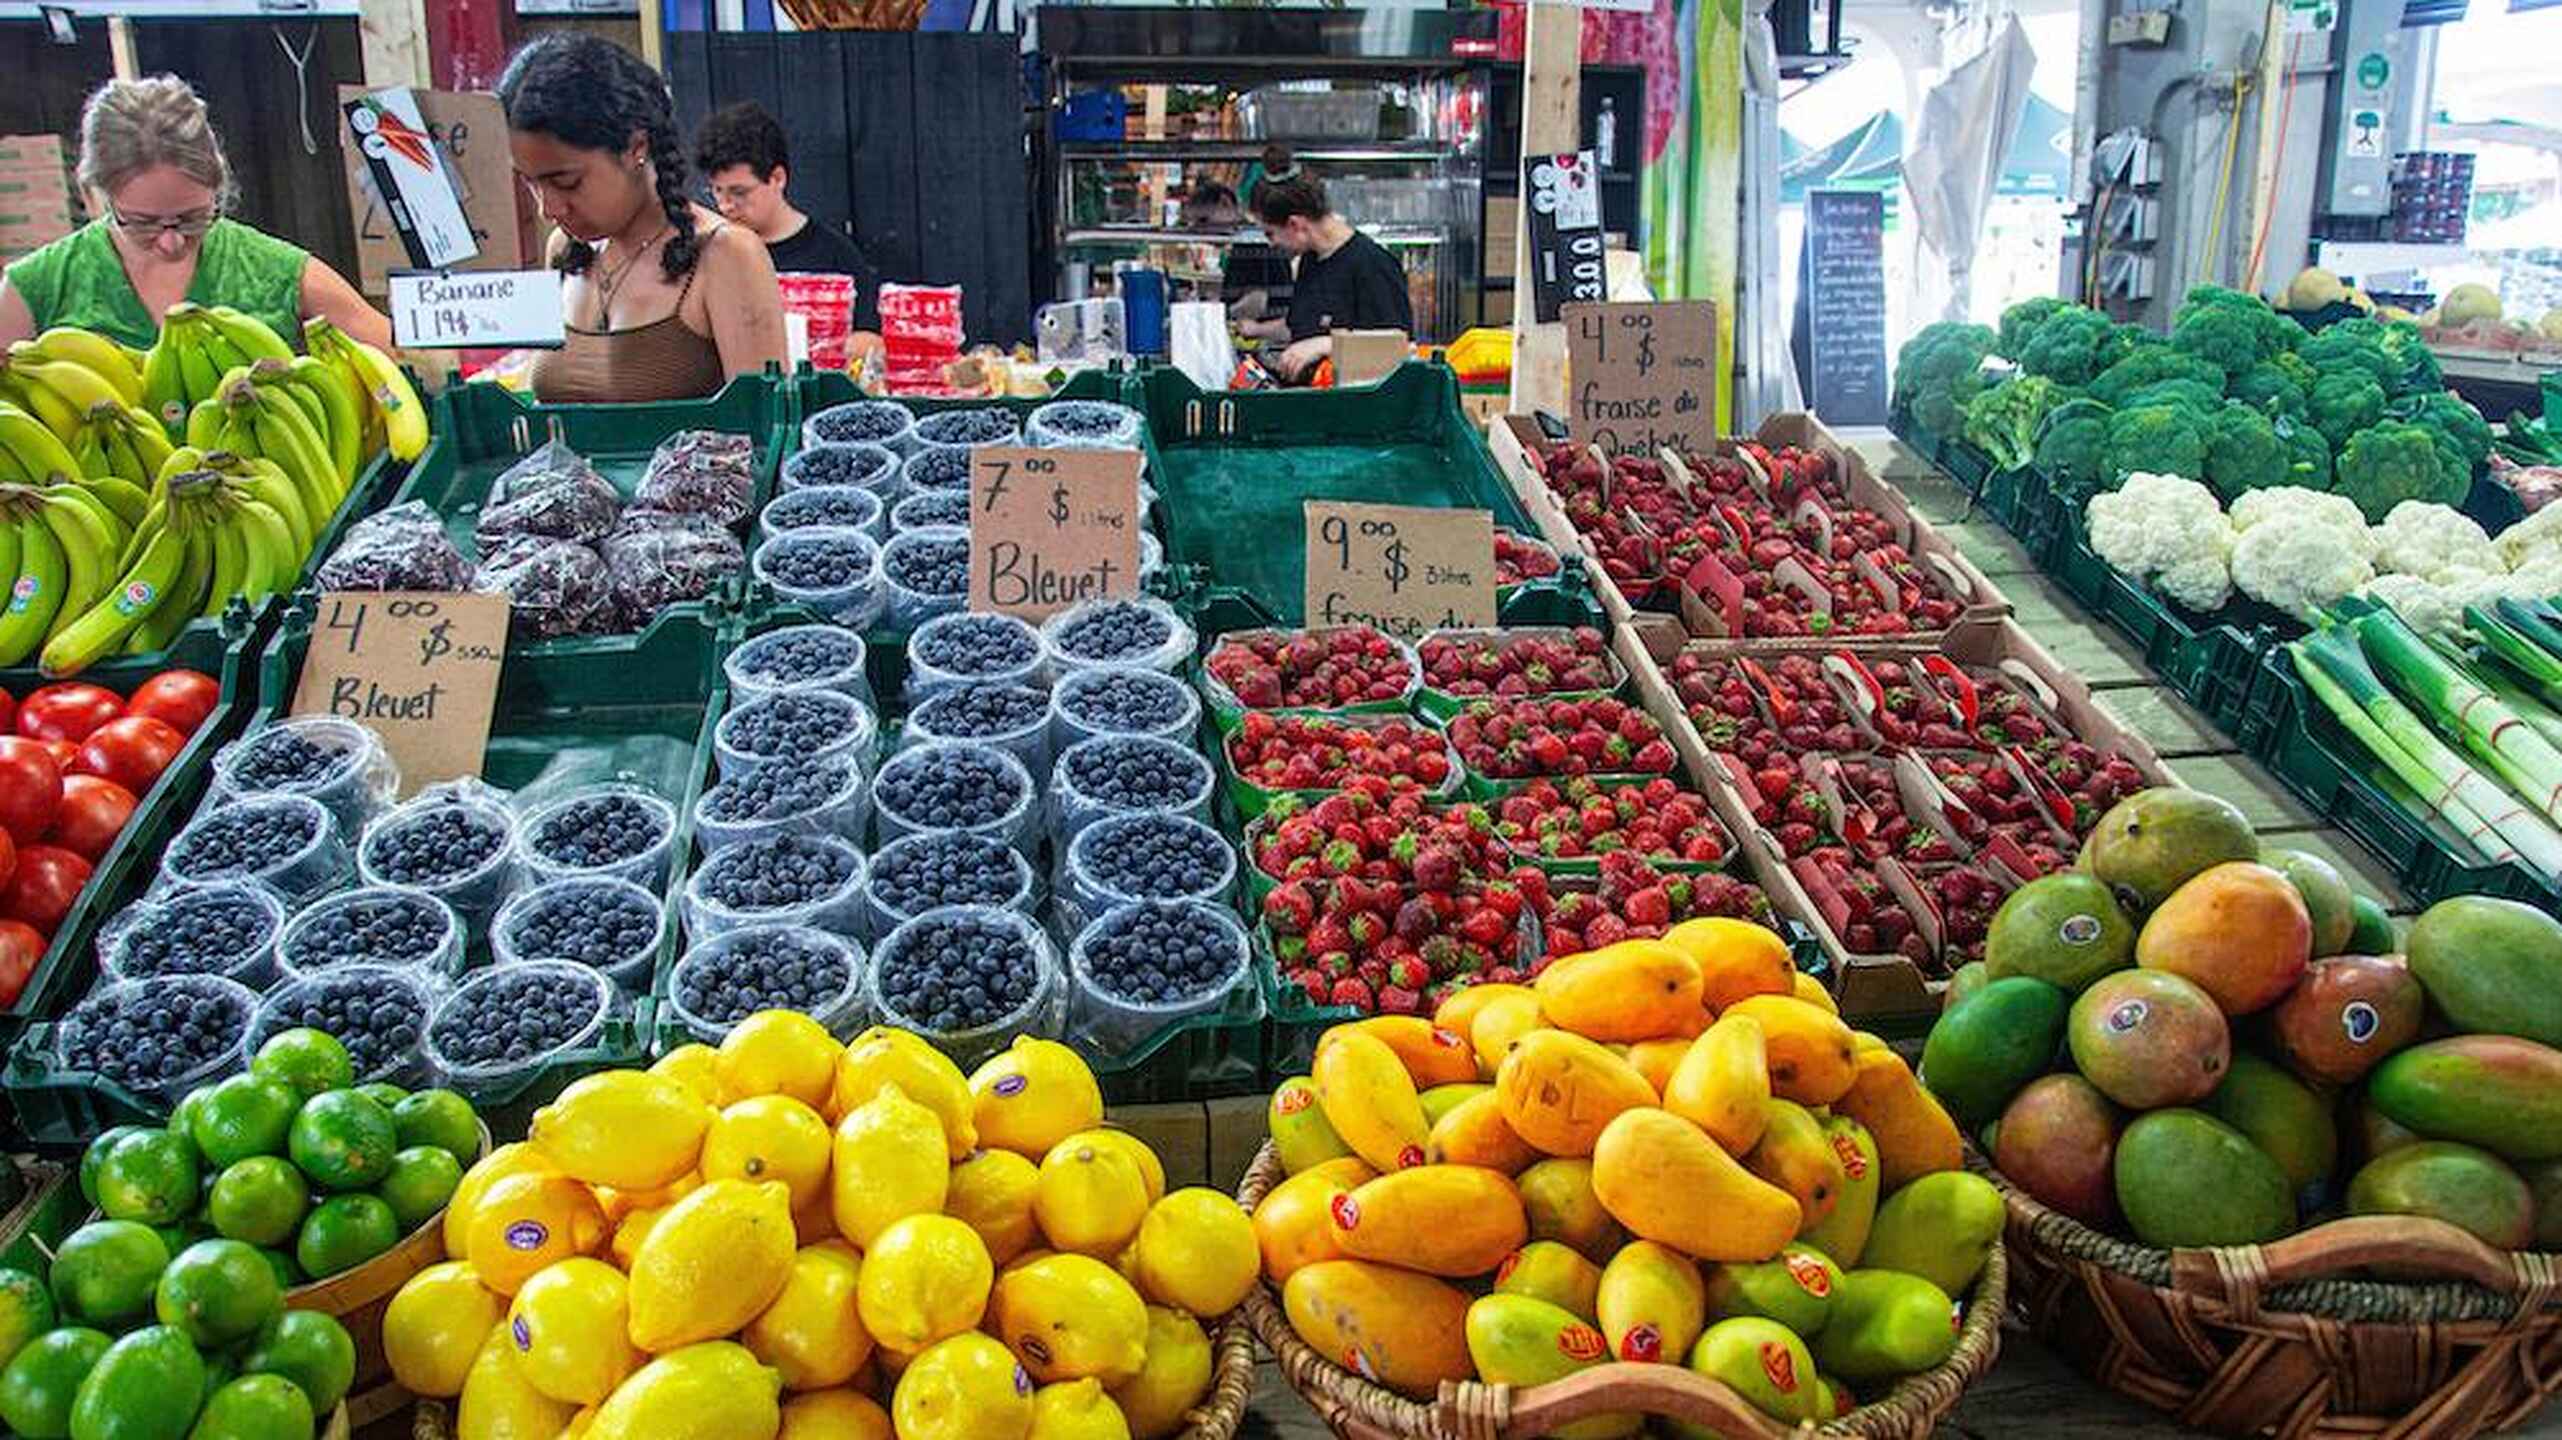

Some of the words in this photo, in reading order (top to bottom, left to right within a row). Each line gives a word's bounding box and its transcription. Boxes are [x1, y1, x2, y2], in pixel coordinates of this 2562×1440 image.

[418, 279, 514, 303] Banane
[1579, 382, 1662, 420] fraise
[1674, 390, 1699, 414] du
[1047, 481, 1070, 530] $
[989, 541, 1119, 606] Bleuet
[1383, 538, 1411, 594] $
[420, 618, 456, 666] $
[331, 676, 447, 720] Bleuet
